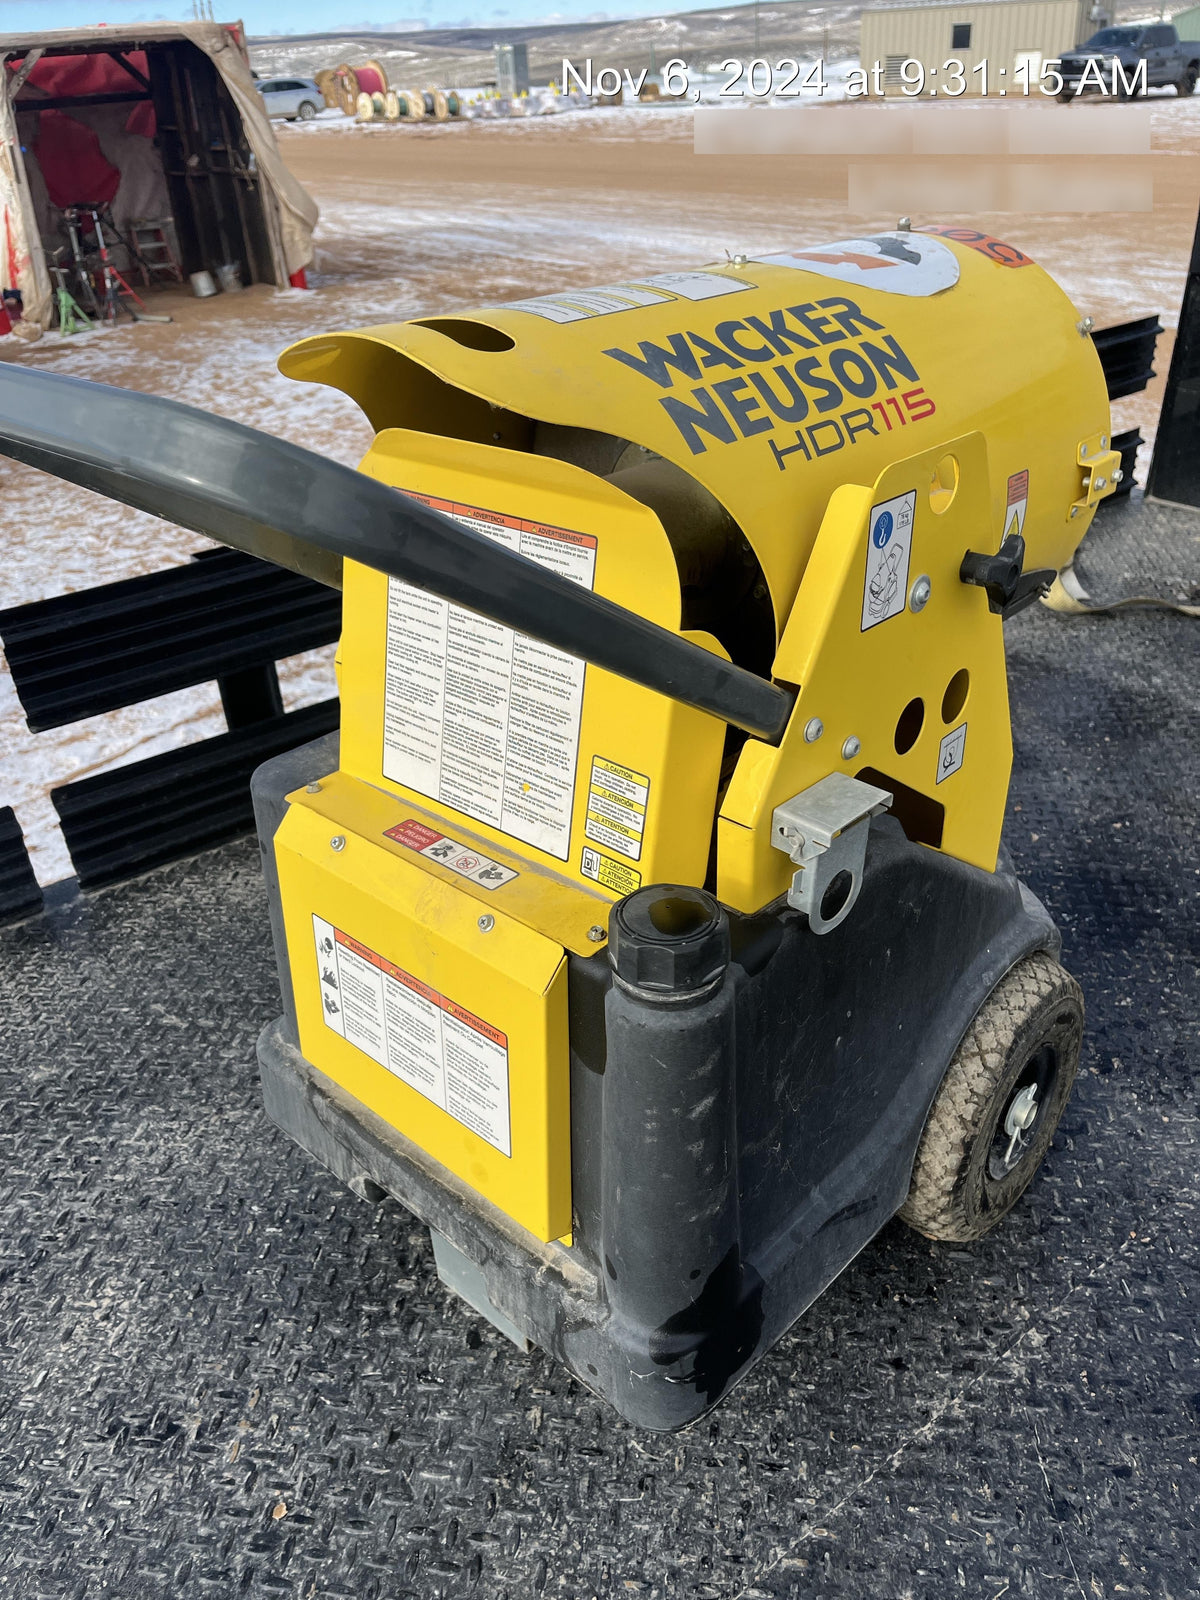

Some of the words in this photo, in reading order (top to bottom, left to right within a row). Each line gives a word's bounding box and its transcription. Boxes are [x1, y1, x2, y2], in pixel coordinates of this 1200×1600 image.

[601, 296, 886, 388] WACKER
[658, 334, 920, 455] NEUSON
[768, 387, 936, 471] HDR115
[609, 764, 633, 780] CAUTION
[600, 816, 629, 835] ATTENTION
[608, 861, 632, 877] CAUTION
